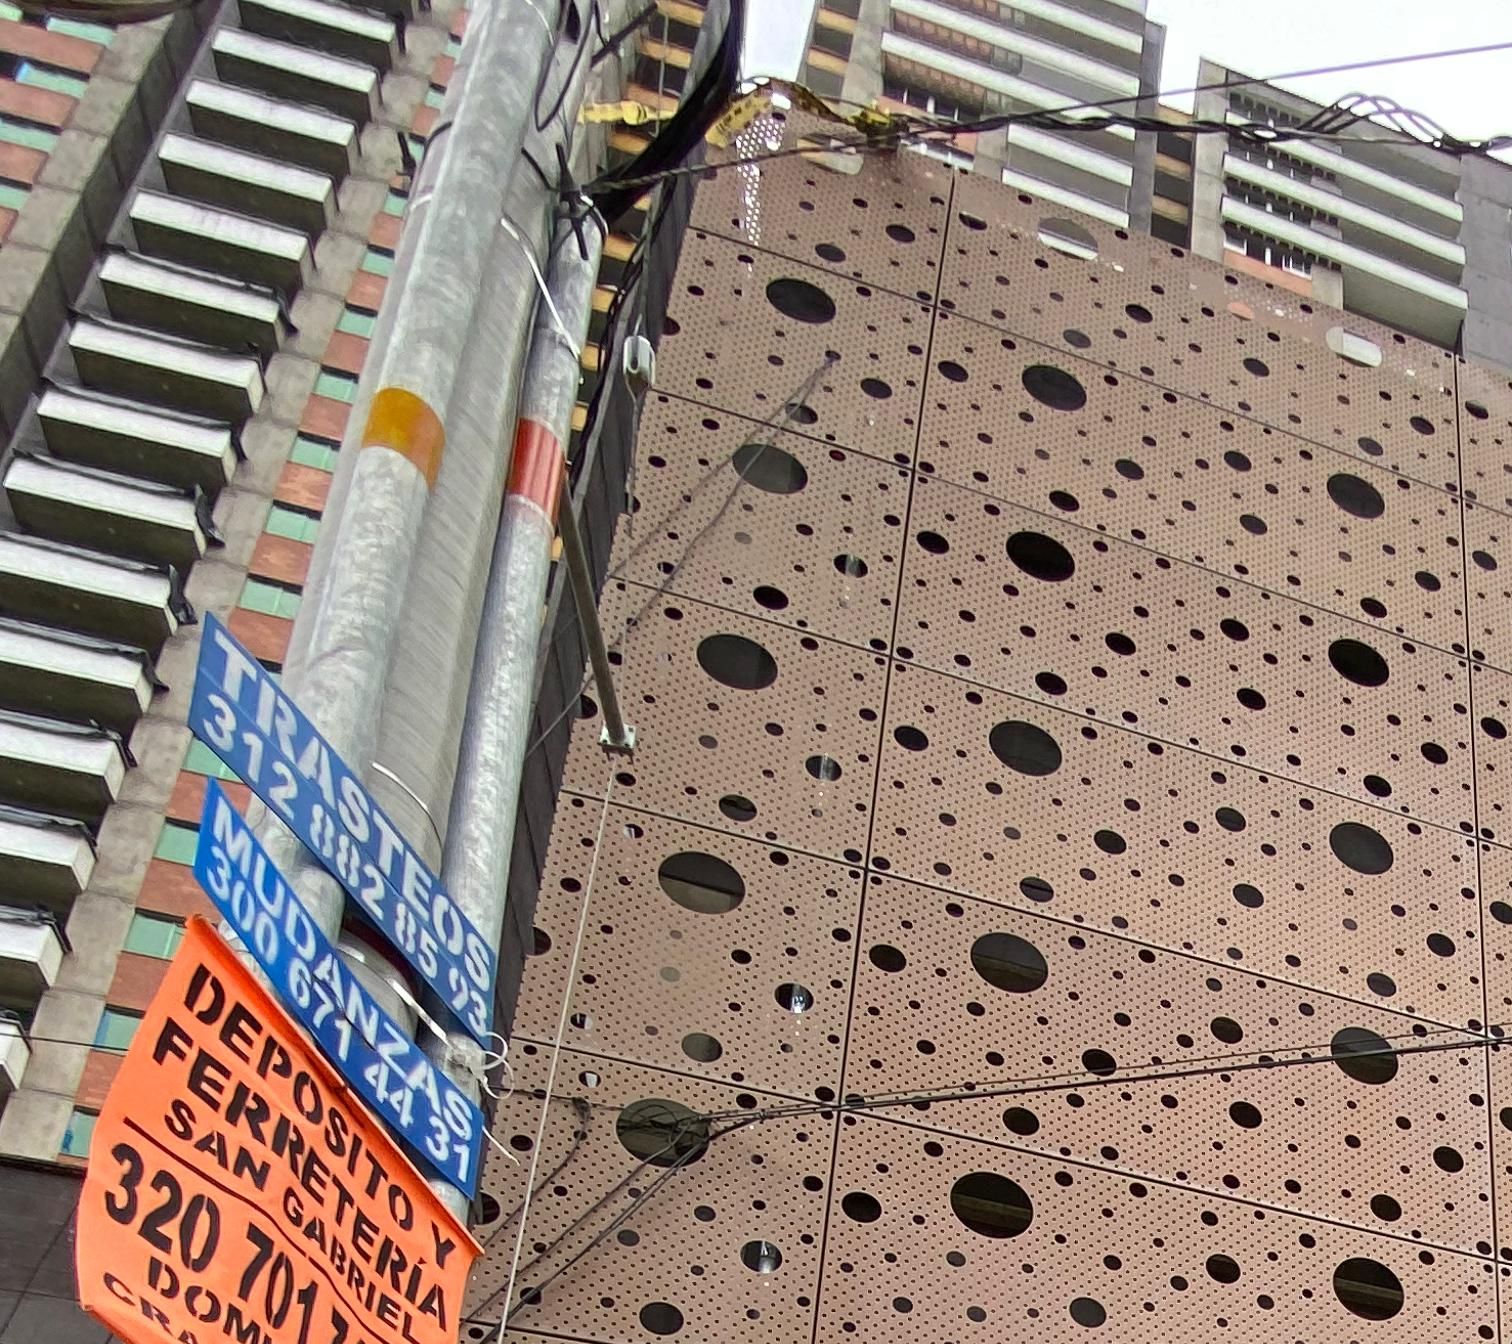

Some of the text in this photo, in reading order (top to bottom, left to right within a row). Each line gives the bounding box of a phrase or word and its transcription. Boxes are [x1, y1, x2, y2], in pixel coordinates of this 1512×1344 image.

[203, 694, 487, 1034] 312 882 85 93
[213, 797, 473, 1140] MUDANZAS
[215, 629, 490, 993] TRASTEOS
[151, 1016, 449, 1333] FERRETERÍA
[163, 1098, 272, 1192] SAN
[182, 962, 457, 1271] DEPOSITO Y
[206, 845, 469, 1184] 300 671 44 31
[104, 1141, 221, 1274] 320
